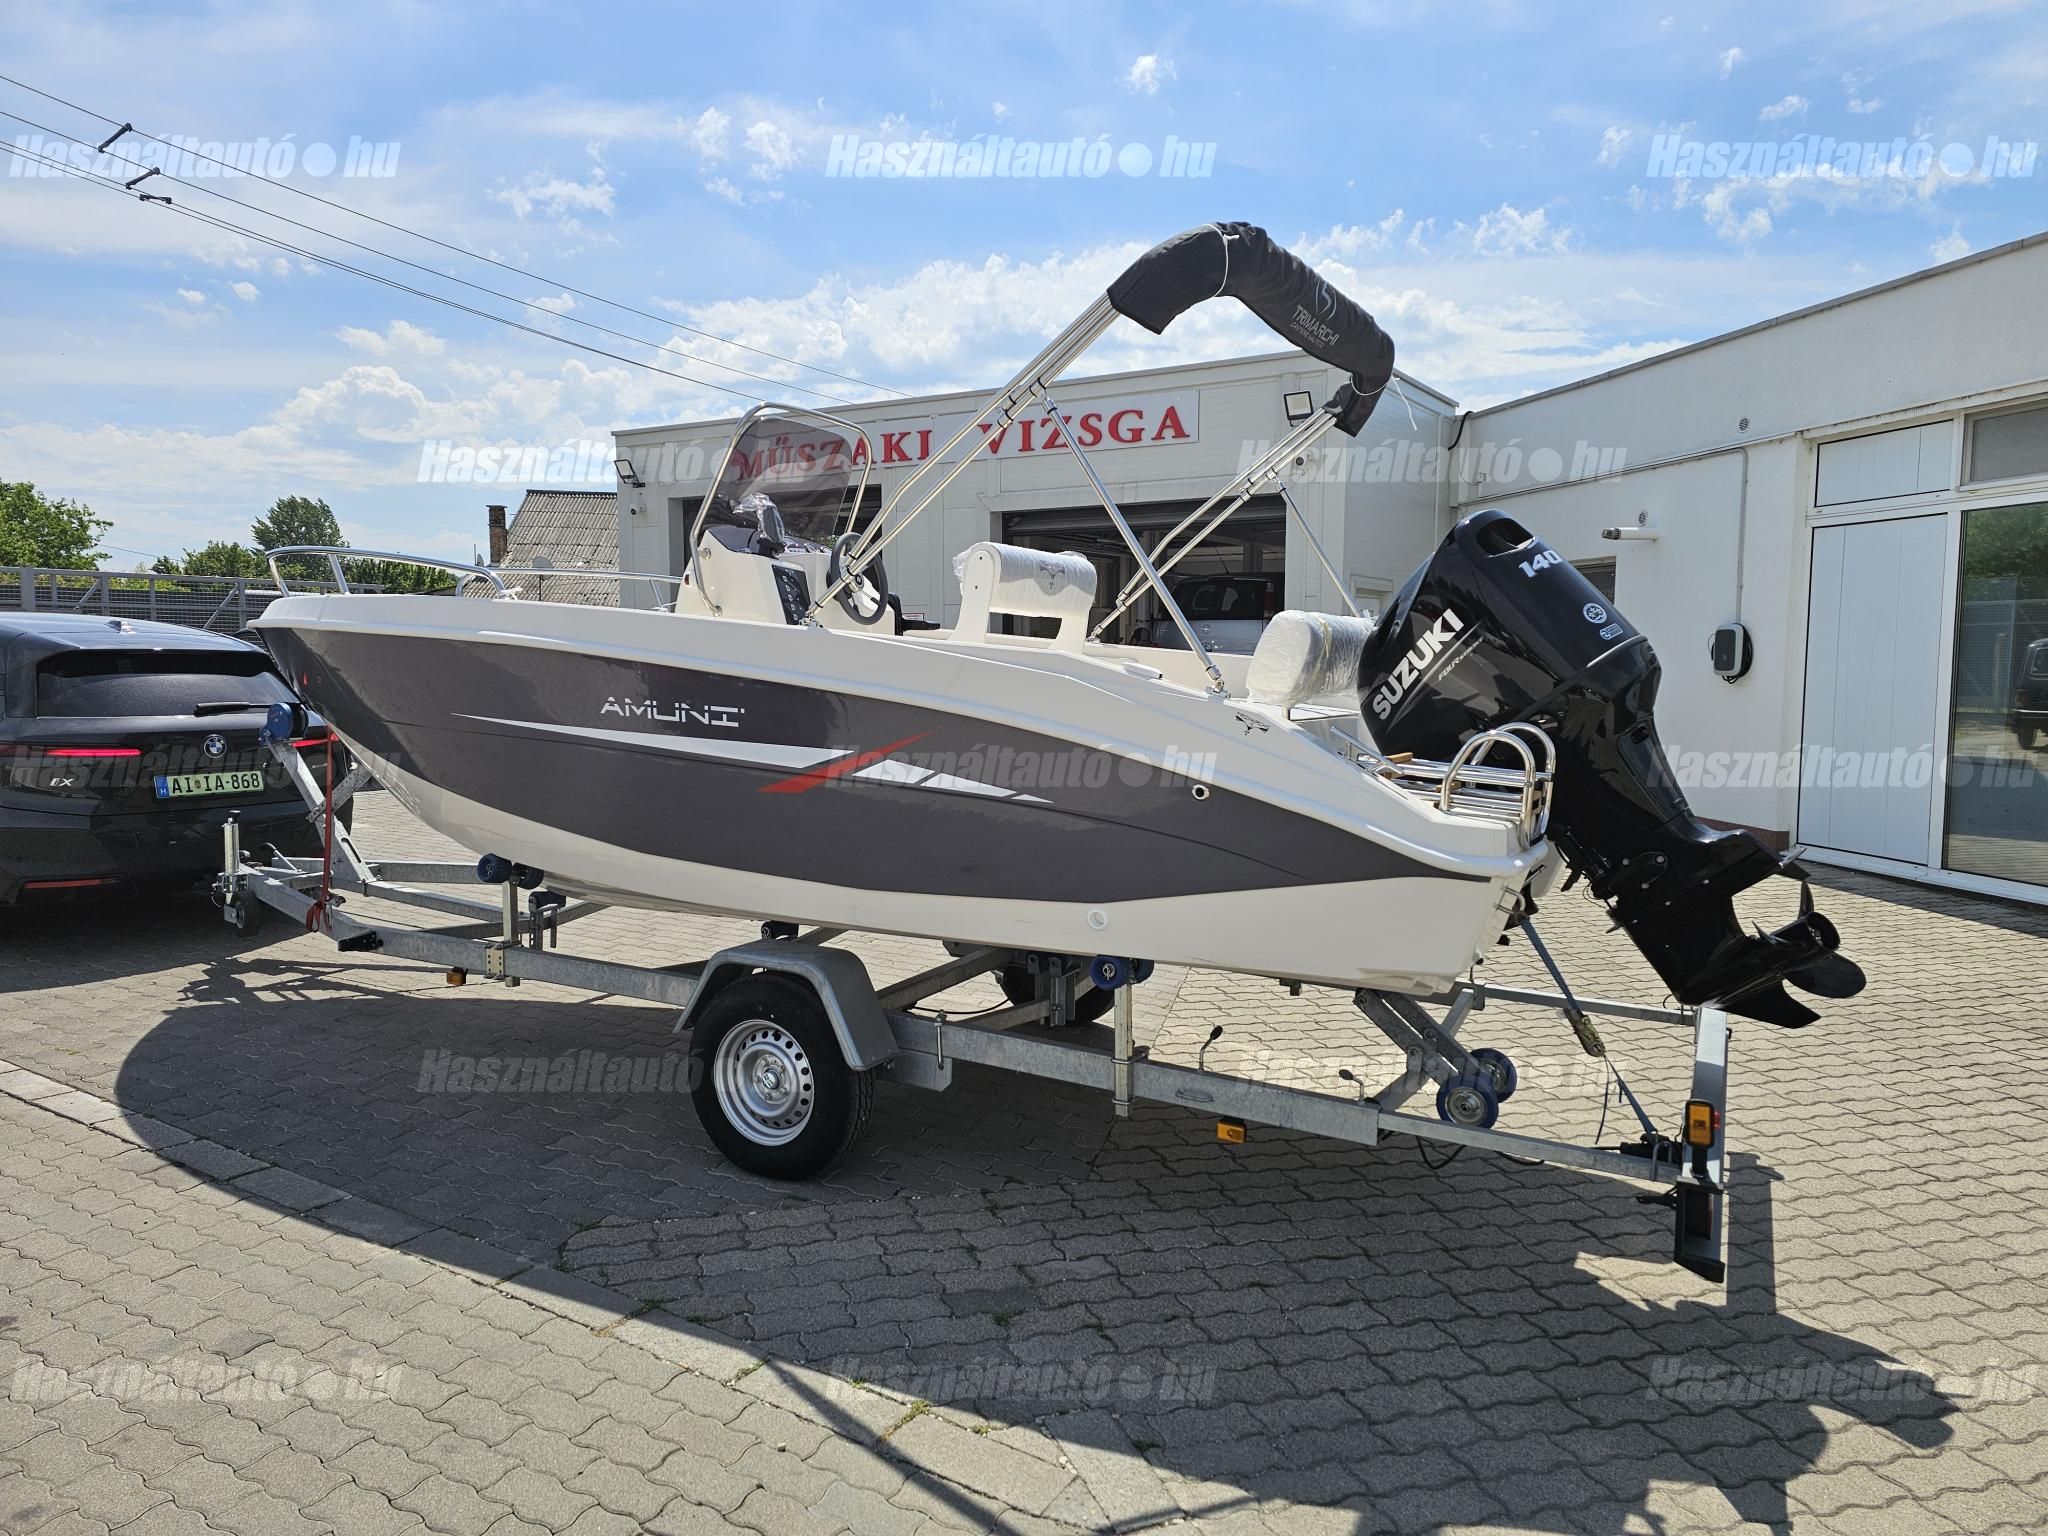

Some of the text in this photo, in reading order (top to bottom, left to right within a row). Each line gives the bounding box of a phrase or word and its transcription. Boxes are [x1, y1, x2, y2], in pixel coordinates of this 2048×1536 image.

[1292, 304, 1340, 346] TRIMARCHI
[735, 429, 933, 482] MŰSZAKI
[976, 405, 1191, 455] VIZSGA
[1518, 550, 1563, 577] 140
[1372, 608, 1465, 720] SUZUKI
[172, 773, 260, 793] AI IA-868
